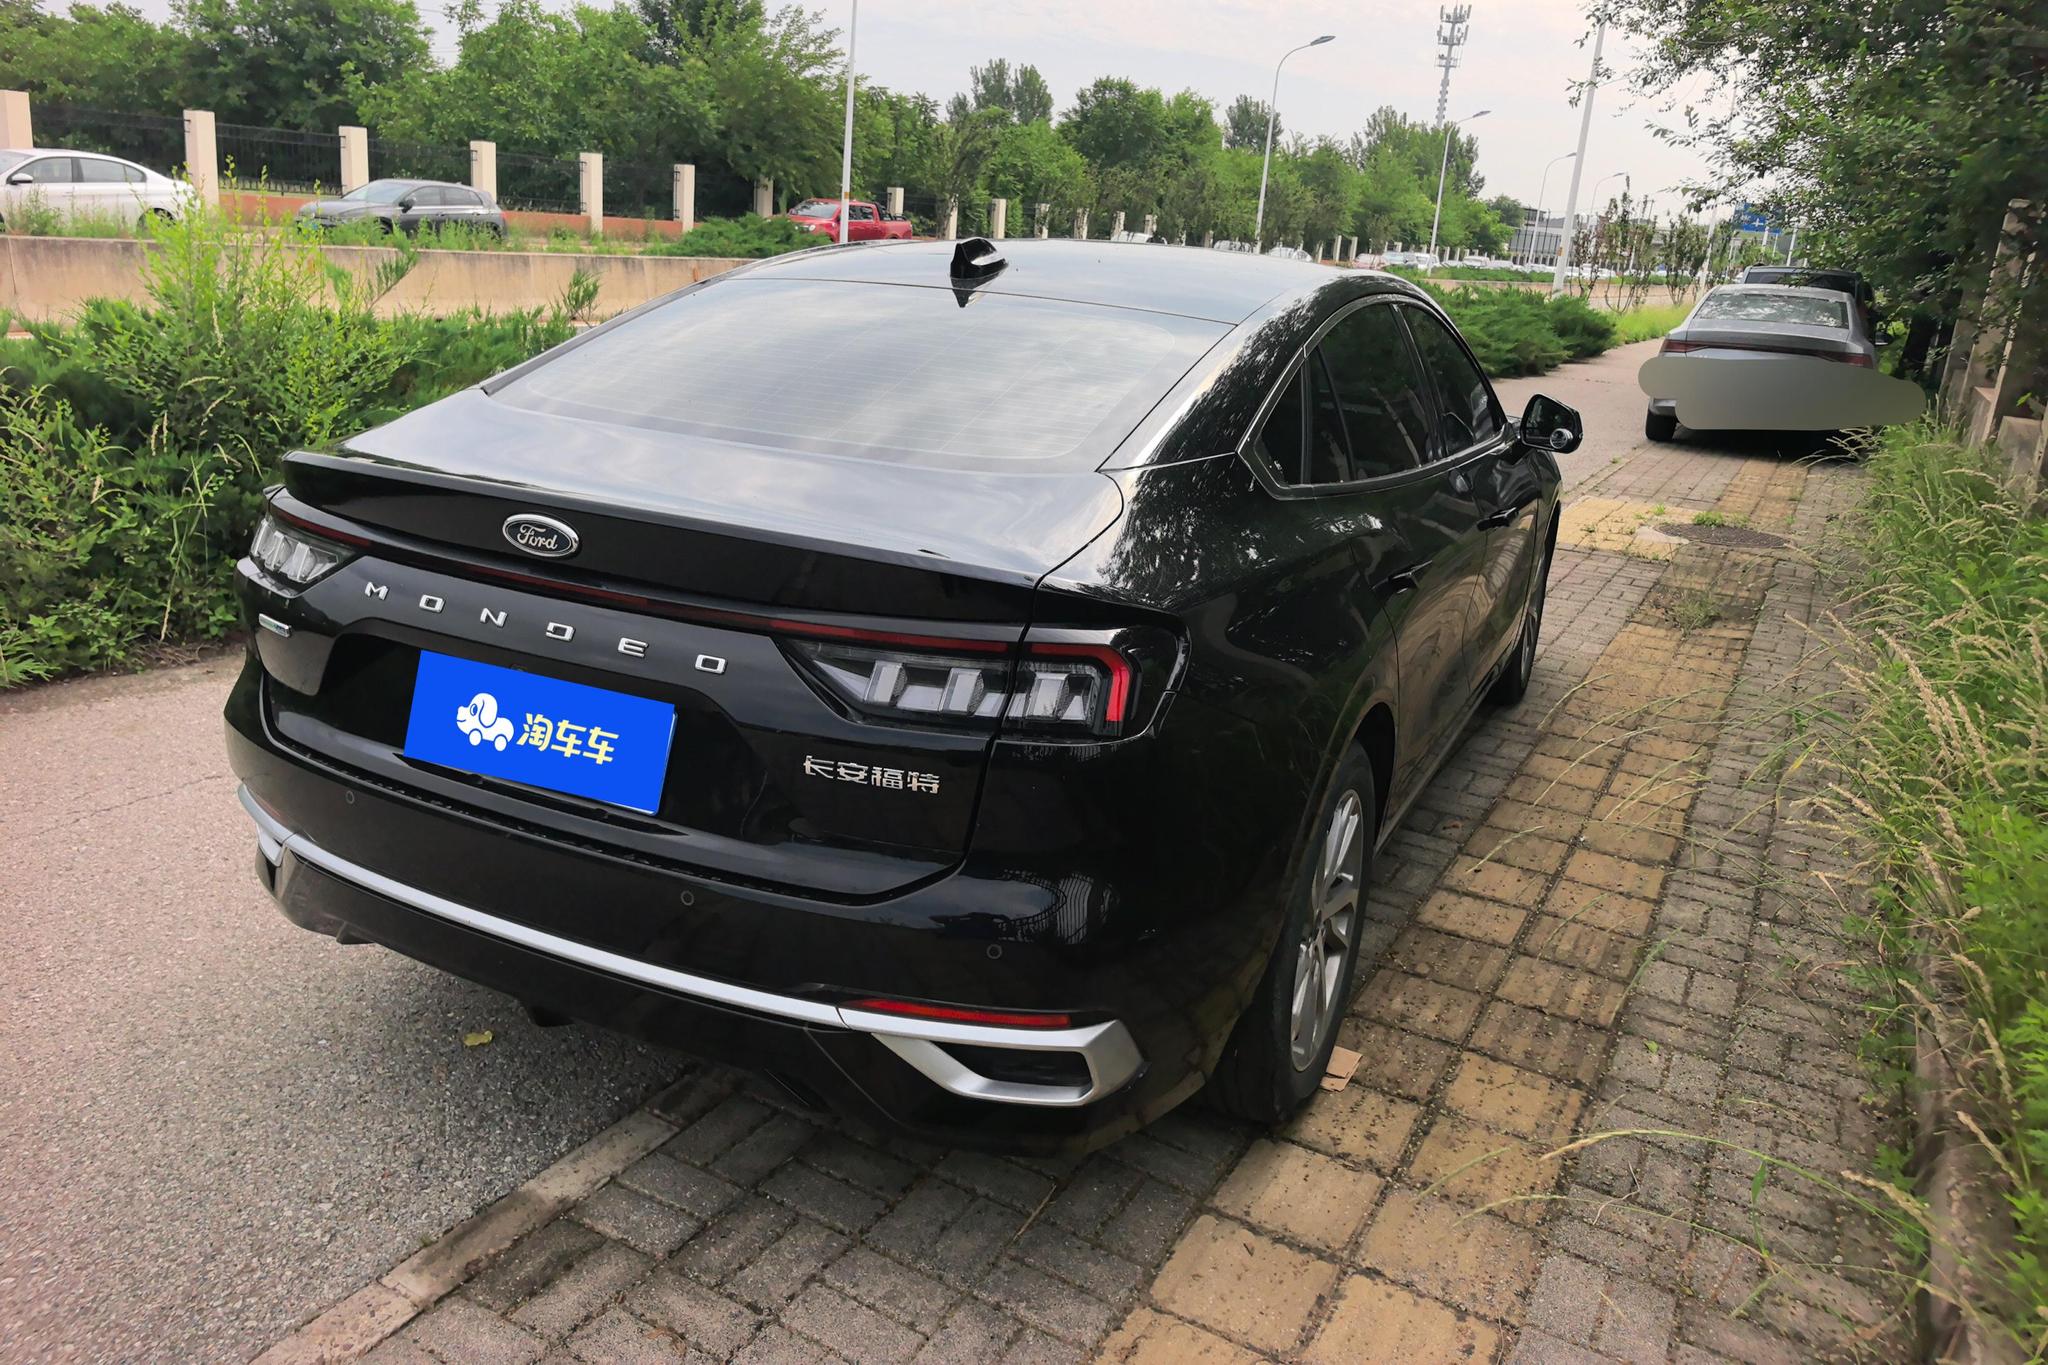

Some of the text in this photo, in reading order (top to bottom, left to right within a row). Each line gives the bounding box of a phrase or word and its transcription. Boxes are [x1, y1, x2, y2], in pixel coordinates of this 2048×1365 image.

[516, 523, 558, 550] Ford
[364, 581, 728, 675] MONDEO
[803, 755, 940, 794] 长安福特
